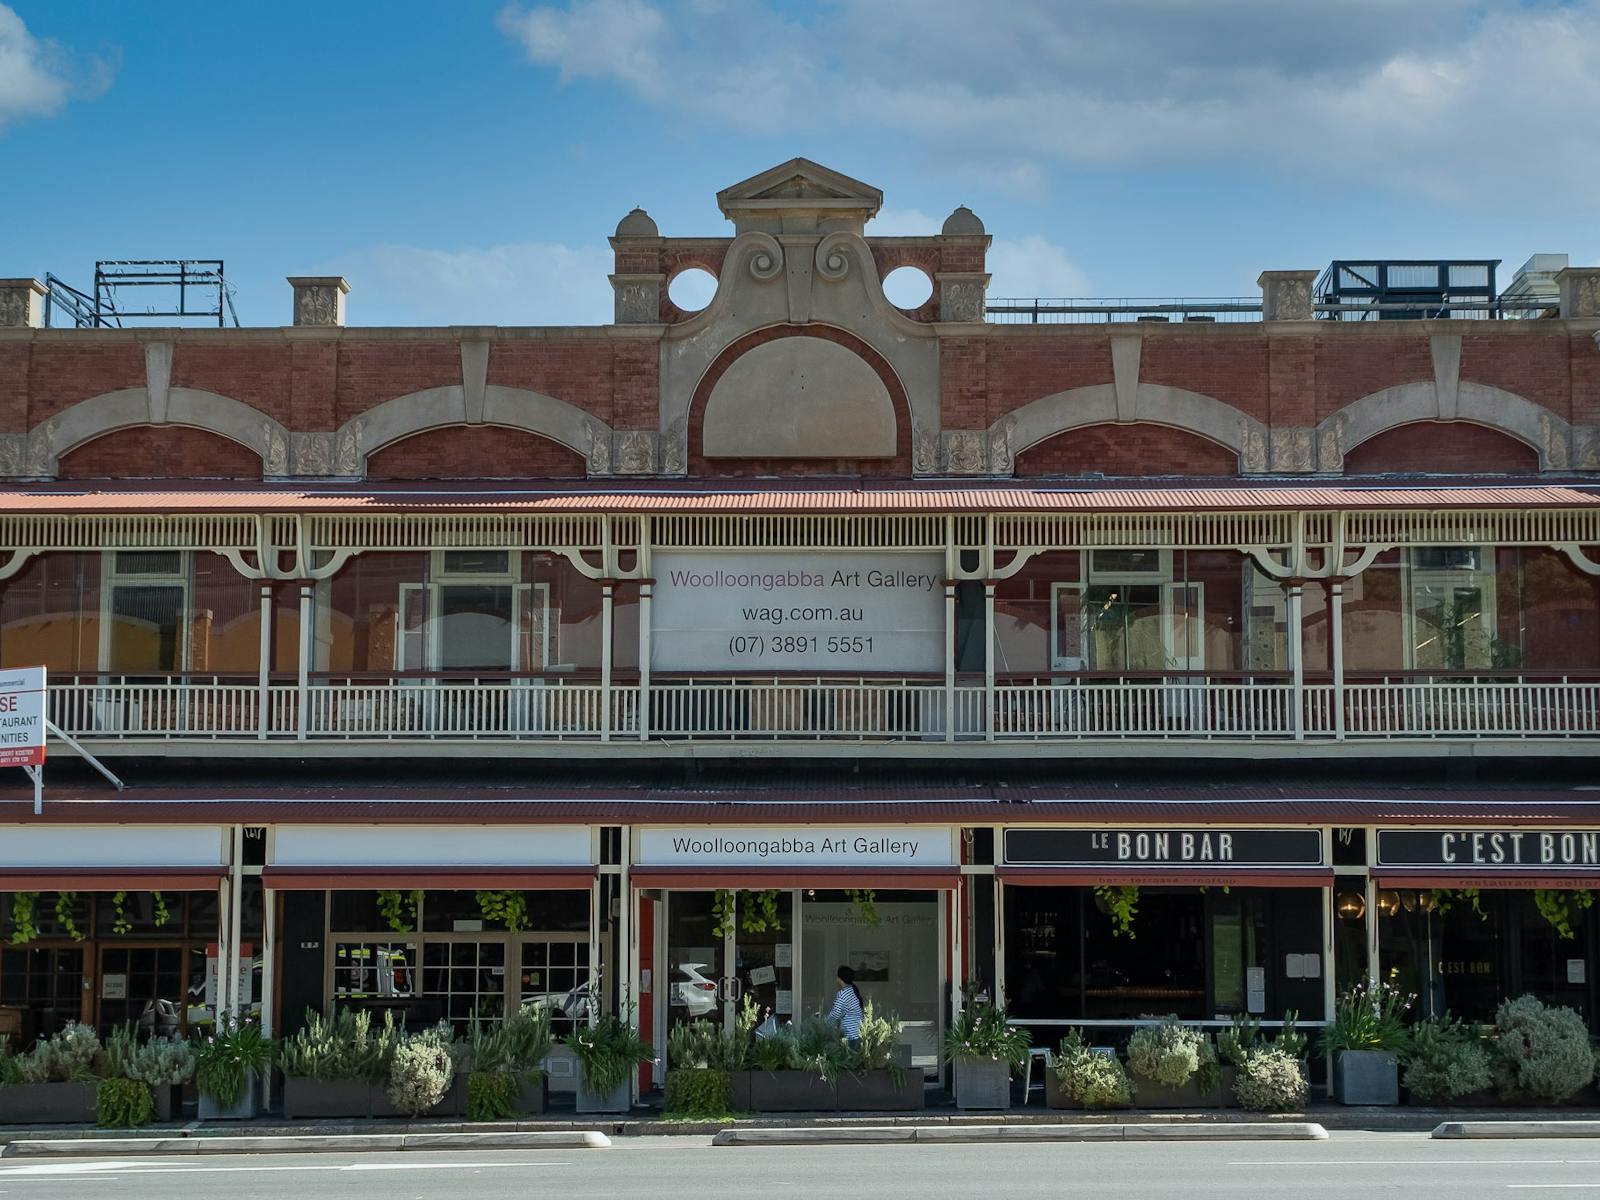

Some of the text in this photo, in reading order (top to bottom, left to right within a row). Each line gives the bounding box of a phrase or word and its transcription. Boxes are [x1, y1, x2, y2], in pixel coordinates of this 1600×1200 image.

[670, 570, 937, 593] Woolloongabba Art Gallery
[742, 607, 863, 625] wag.com.au
[729, 636, 873, 656] (07) 3891 5551
[673, 838, 919, 857] Woolloongabba Art Gallery
[1092, 832, 1233, 860] LE BON BAR
[1441, 833, 1600, 864] C'EST BON
